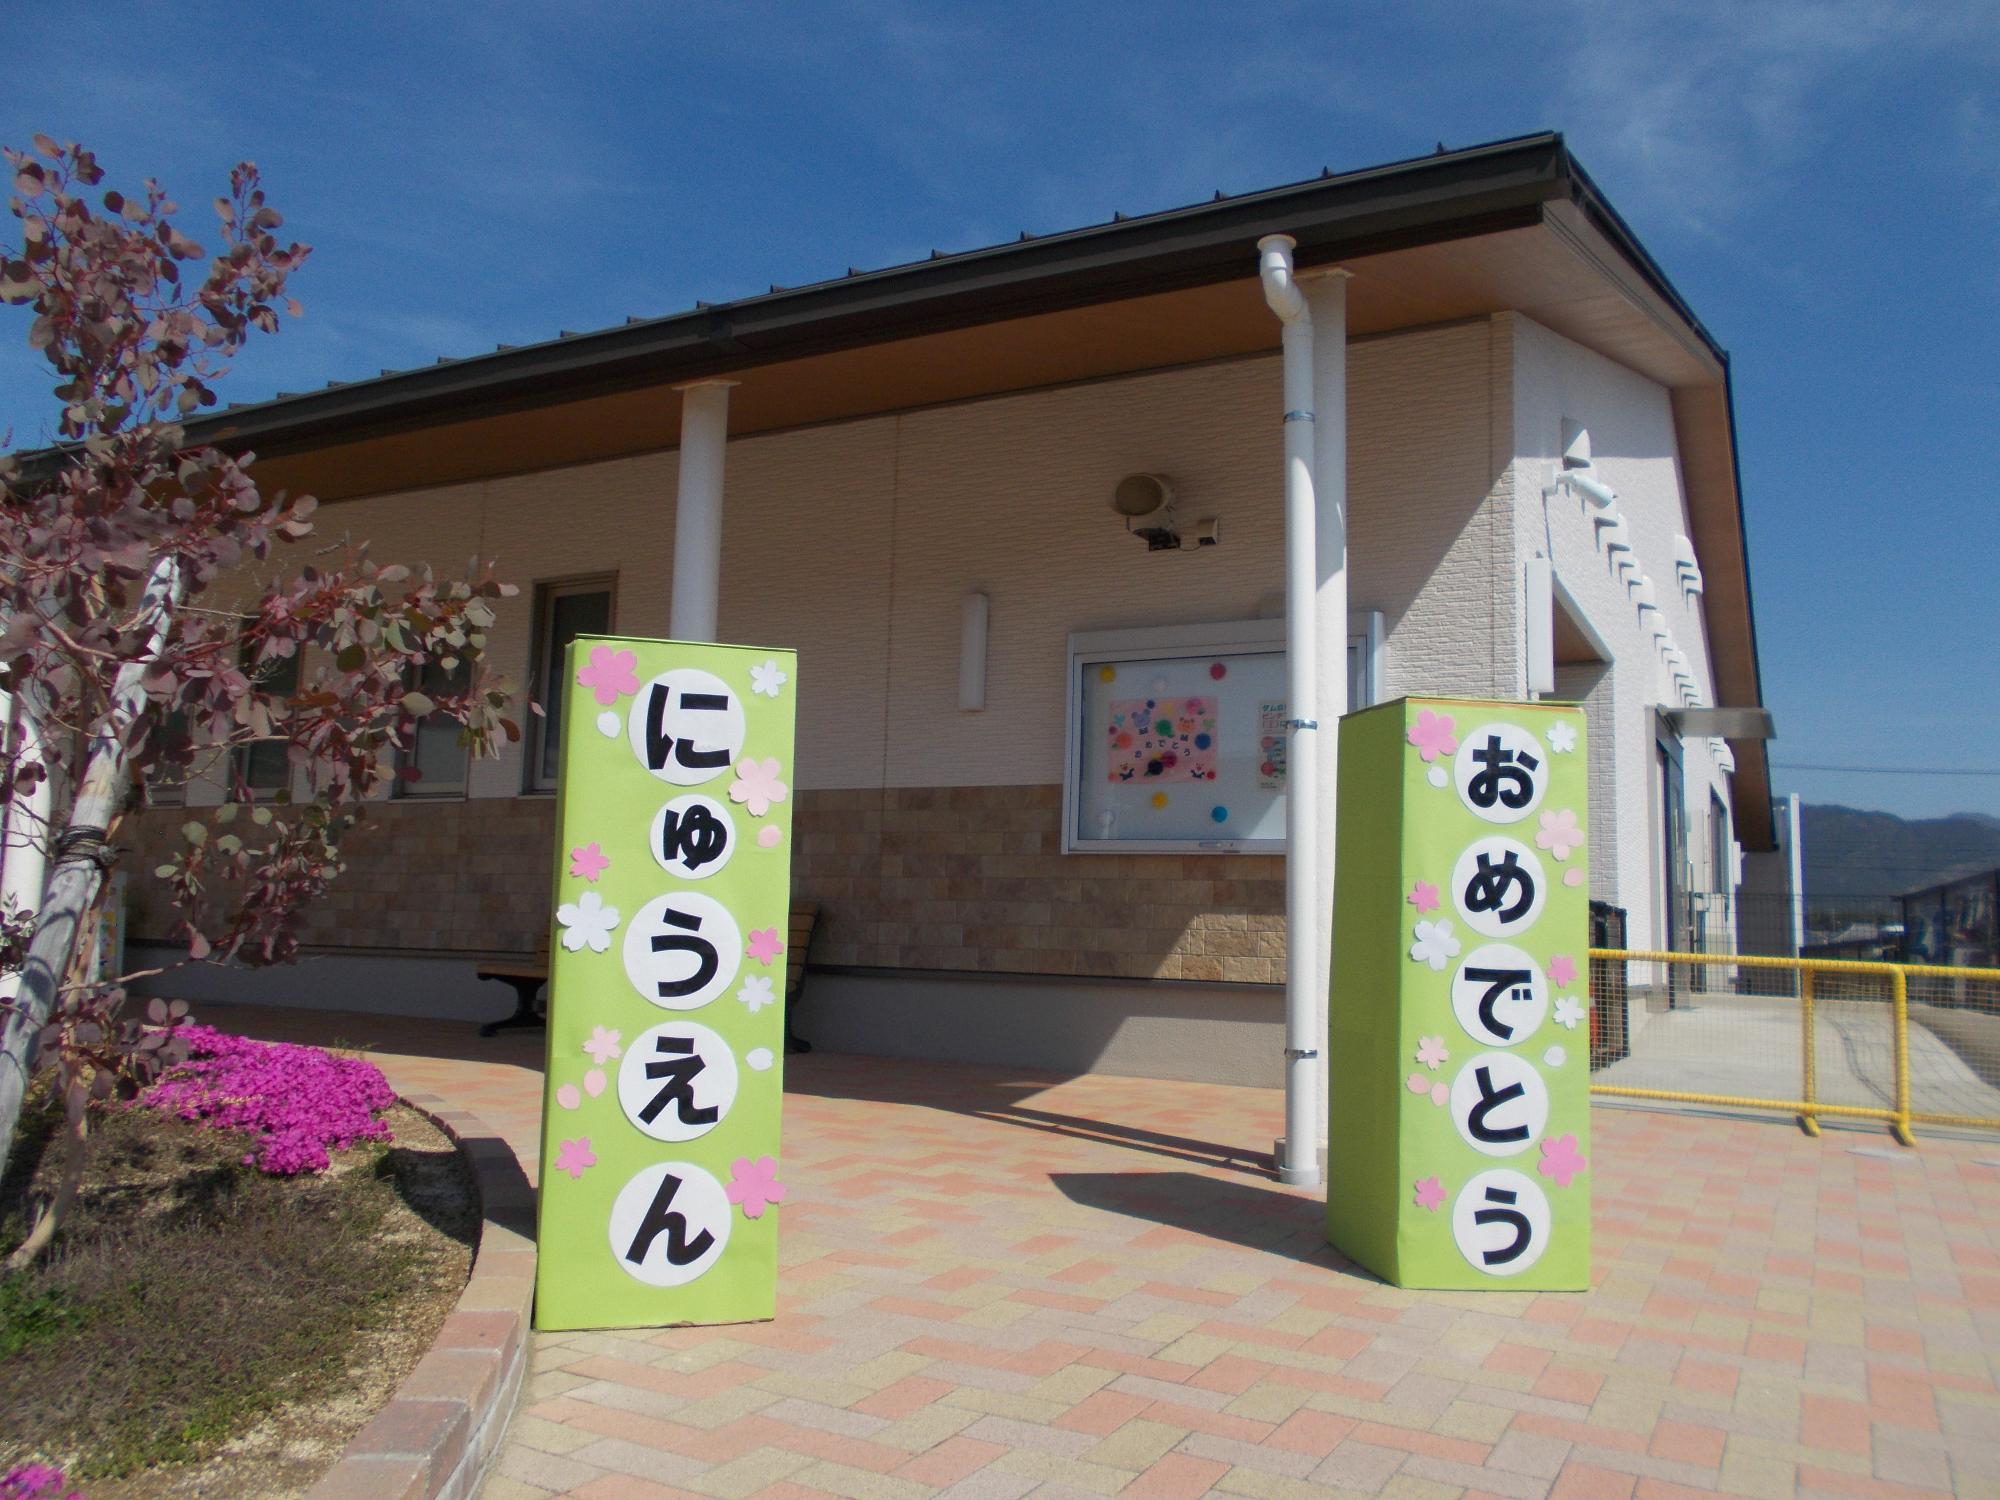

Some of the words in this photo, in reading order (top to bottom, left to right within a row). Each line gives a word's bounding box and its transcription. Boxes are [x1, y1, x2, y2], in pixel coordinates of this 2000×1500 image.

[625, 682, 731, 1267] にゅうえん
[1134, 738, 1191, 759] おめでとう
[1464, 734, 1538, 1265] おめでとう
